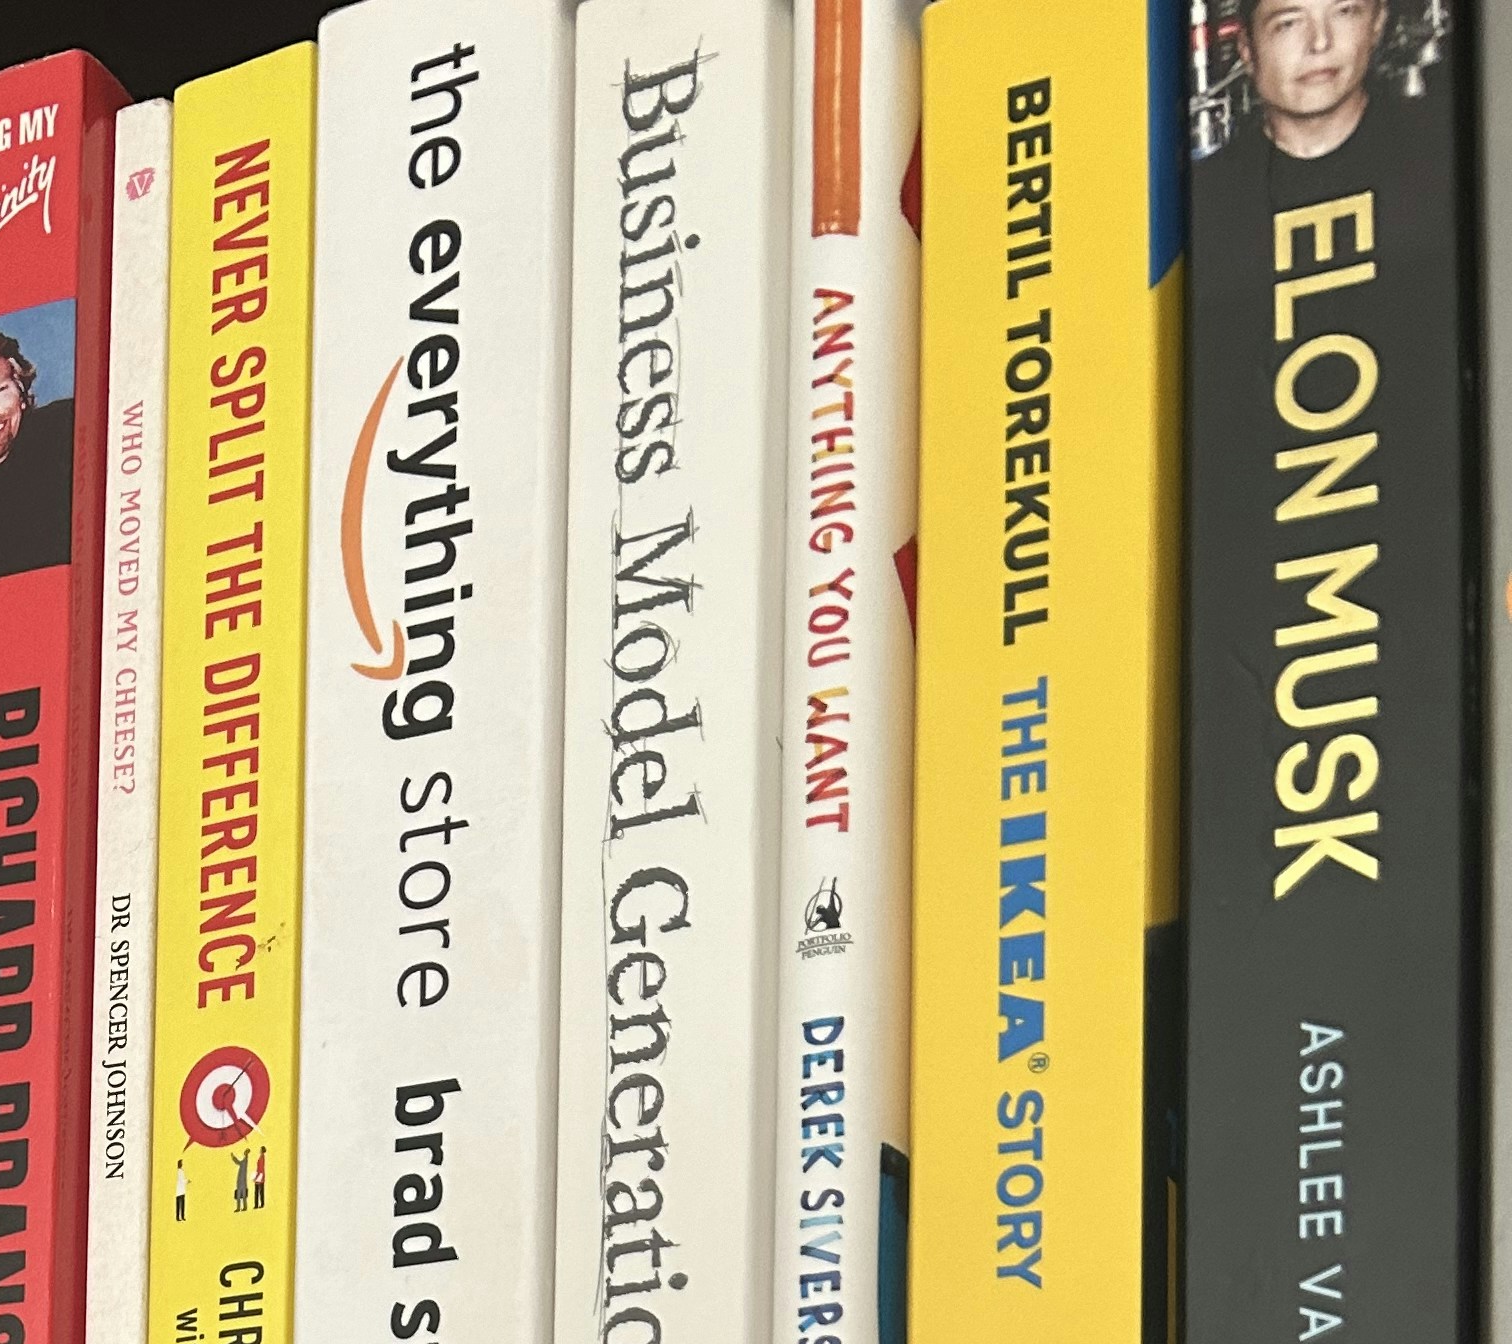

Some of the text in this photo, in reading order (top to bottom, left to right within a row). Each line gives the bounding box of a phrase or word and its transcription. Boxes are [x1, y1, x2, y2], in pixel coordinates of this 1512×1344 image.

[19, 103, 59, 143] MY
[612, 40, 718, 486] Business
[381, 41, 481, 1009] the everything store
[803, 286, 858, 834] ANYTHING YOU WANT
[1003, 76, 1054, 648] BERTIL TOREKULL
[1273, 189, 1381, 901] ELON MUSK
[111, 399, 145, 796] WHO MOVED MY CHEESE?
[197, 137, 272, 1010] NEVER SPLIT THE DIFFERENCE
[603, 504, 704, 842] Model
[101, 892, 131, 1181] DR SPENCER JOHNSON
[390, 1075, 462, 1270] brad
[800, 1014, 846, 1175] DEREK
[1298, 1020, 1345, 1241] ASHLEE
